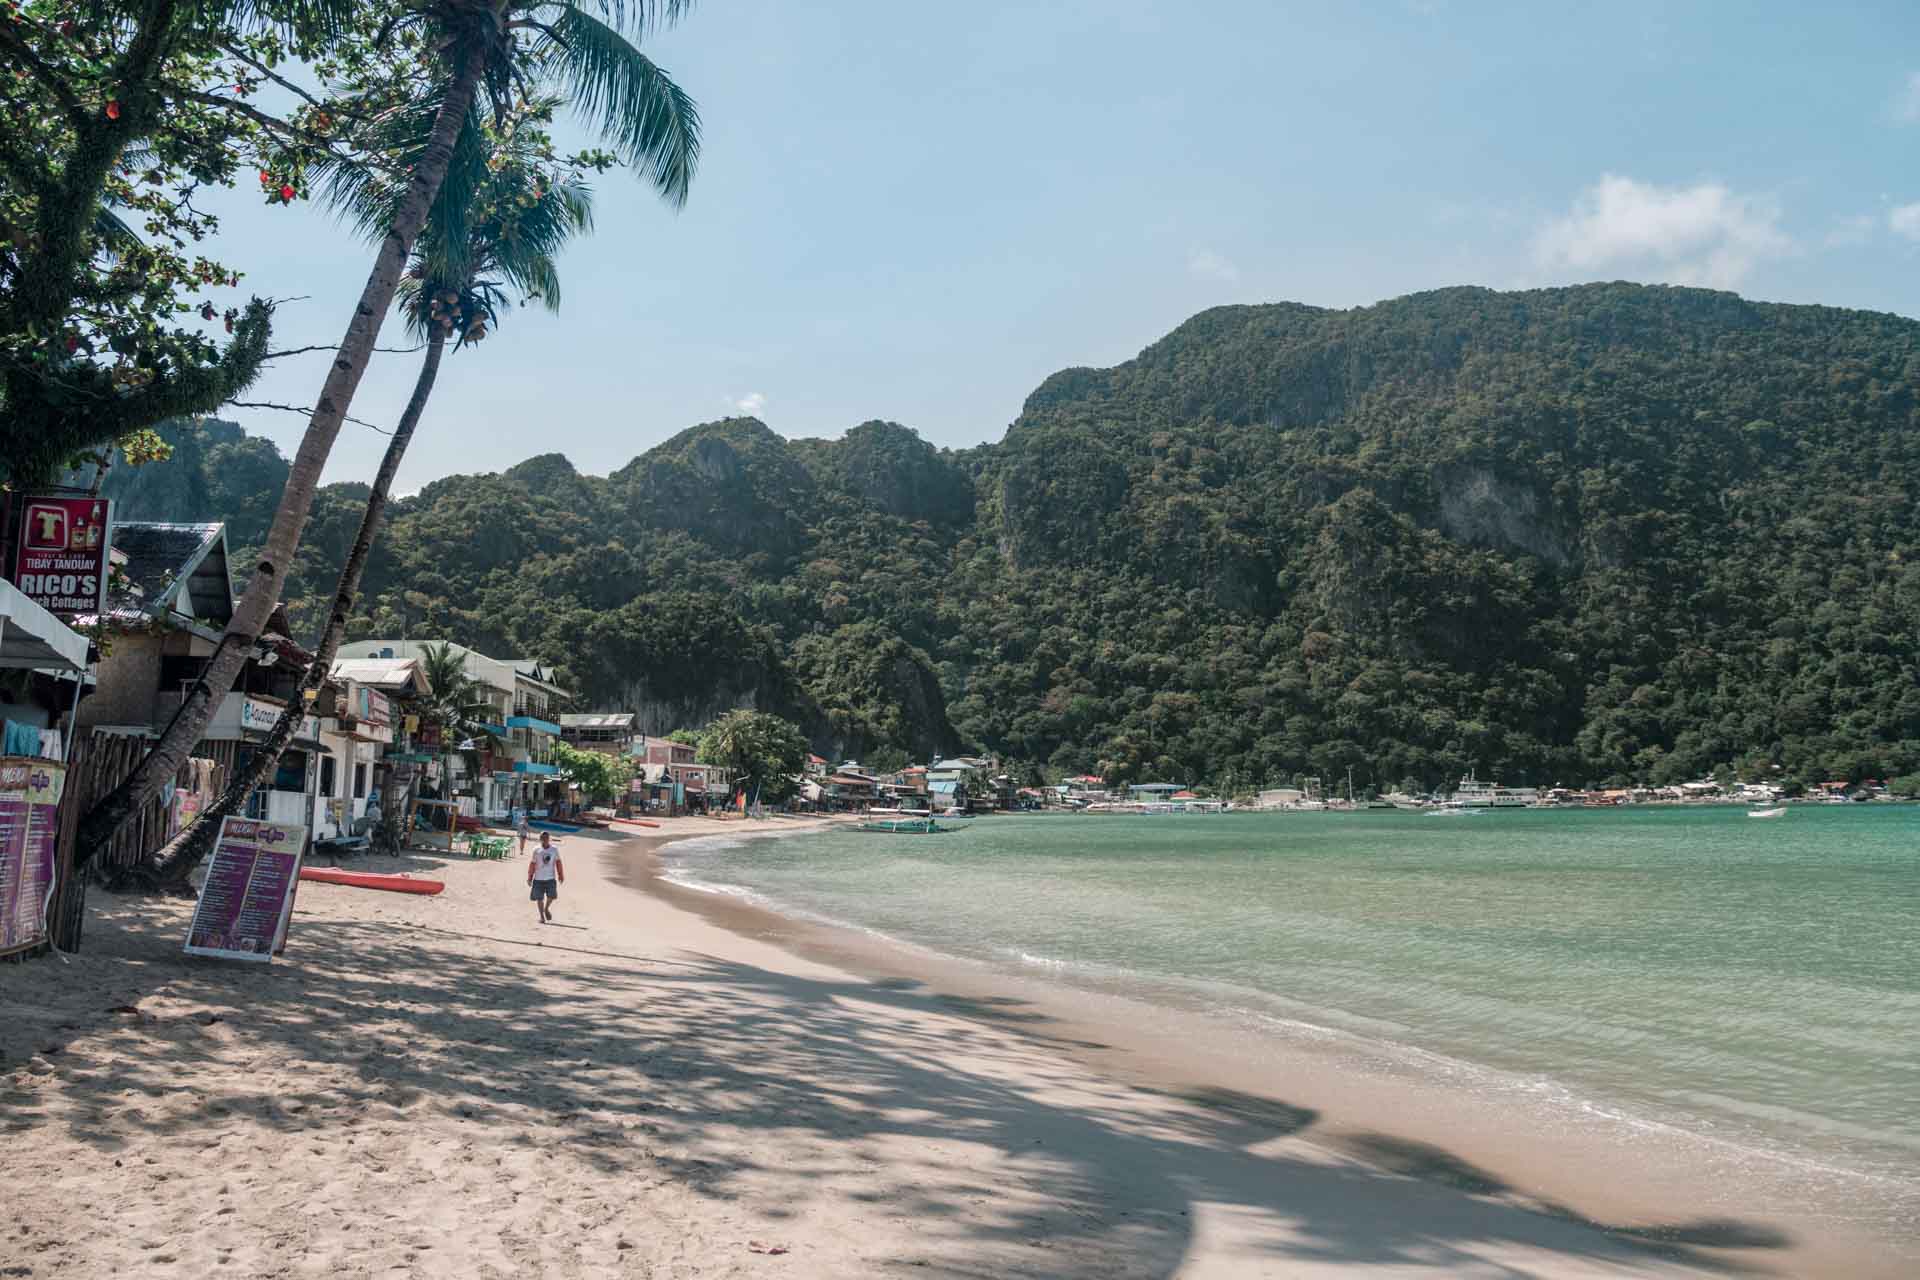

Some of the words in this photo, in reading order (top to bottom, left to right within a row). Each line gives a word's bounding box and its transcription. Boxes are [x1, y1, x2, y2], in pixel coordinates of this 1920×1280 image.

[26, 558, 51, 569] TIBAY
[54, 559, 96, 570] TANDUAY
[21, 574, 96, 595] RICO'S
[51, 596, 95, 609] Cottages
